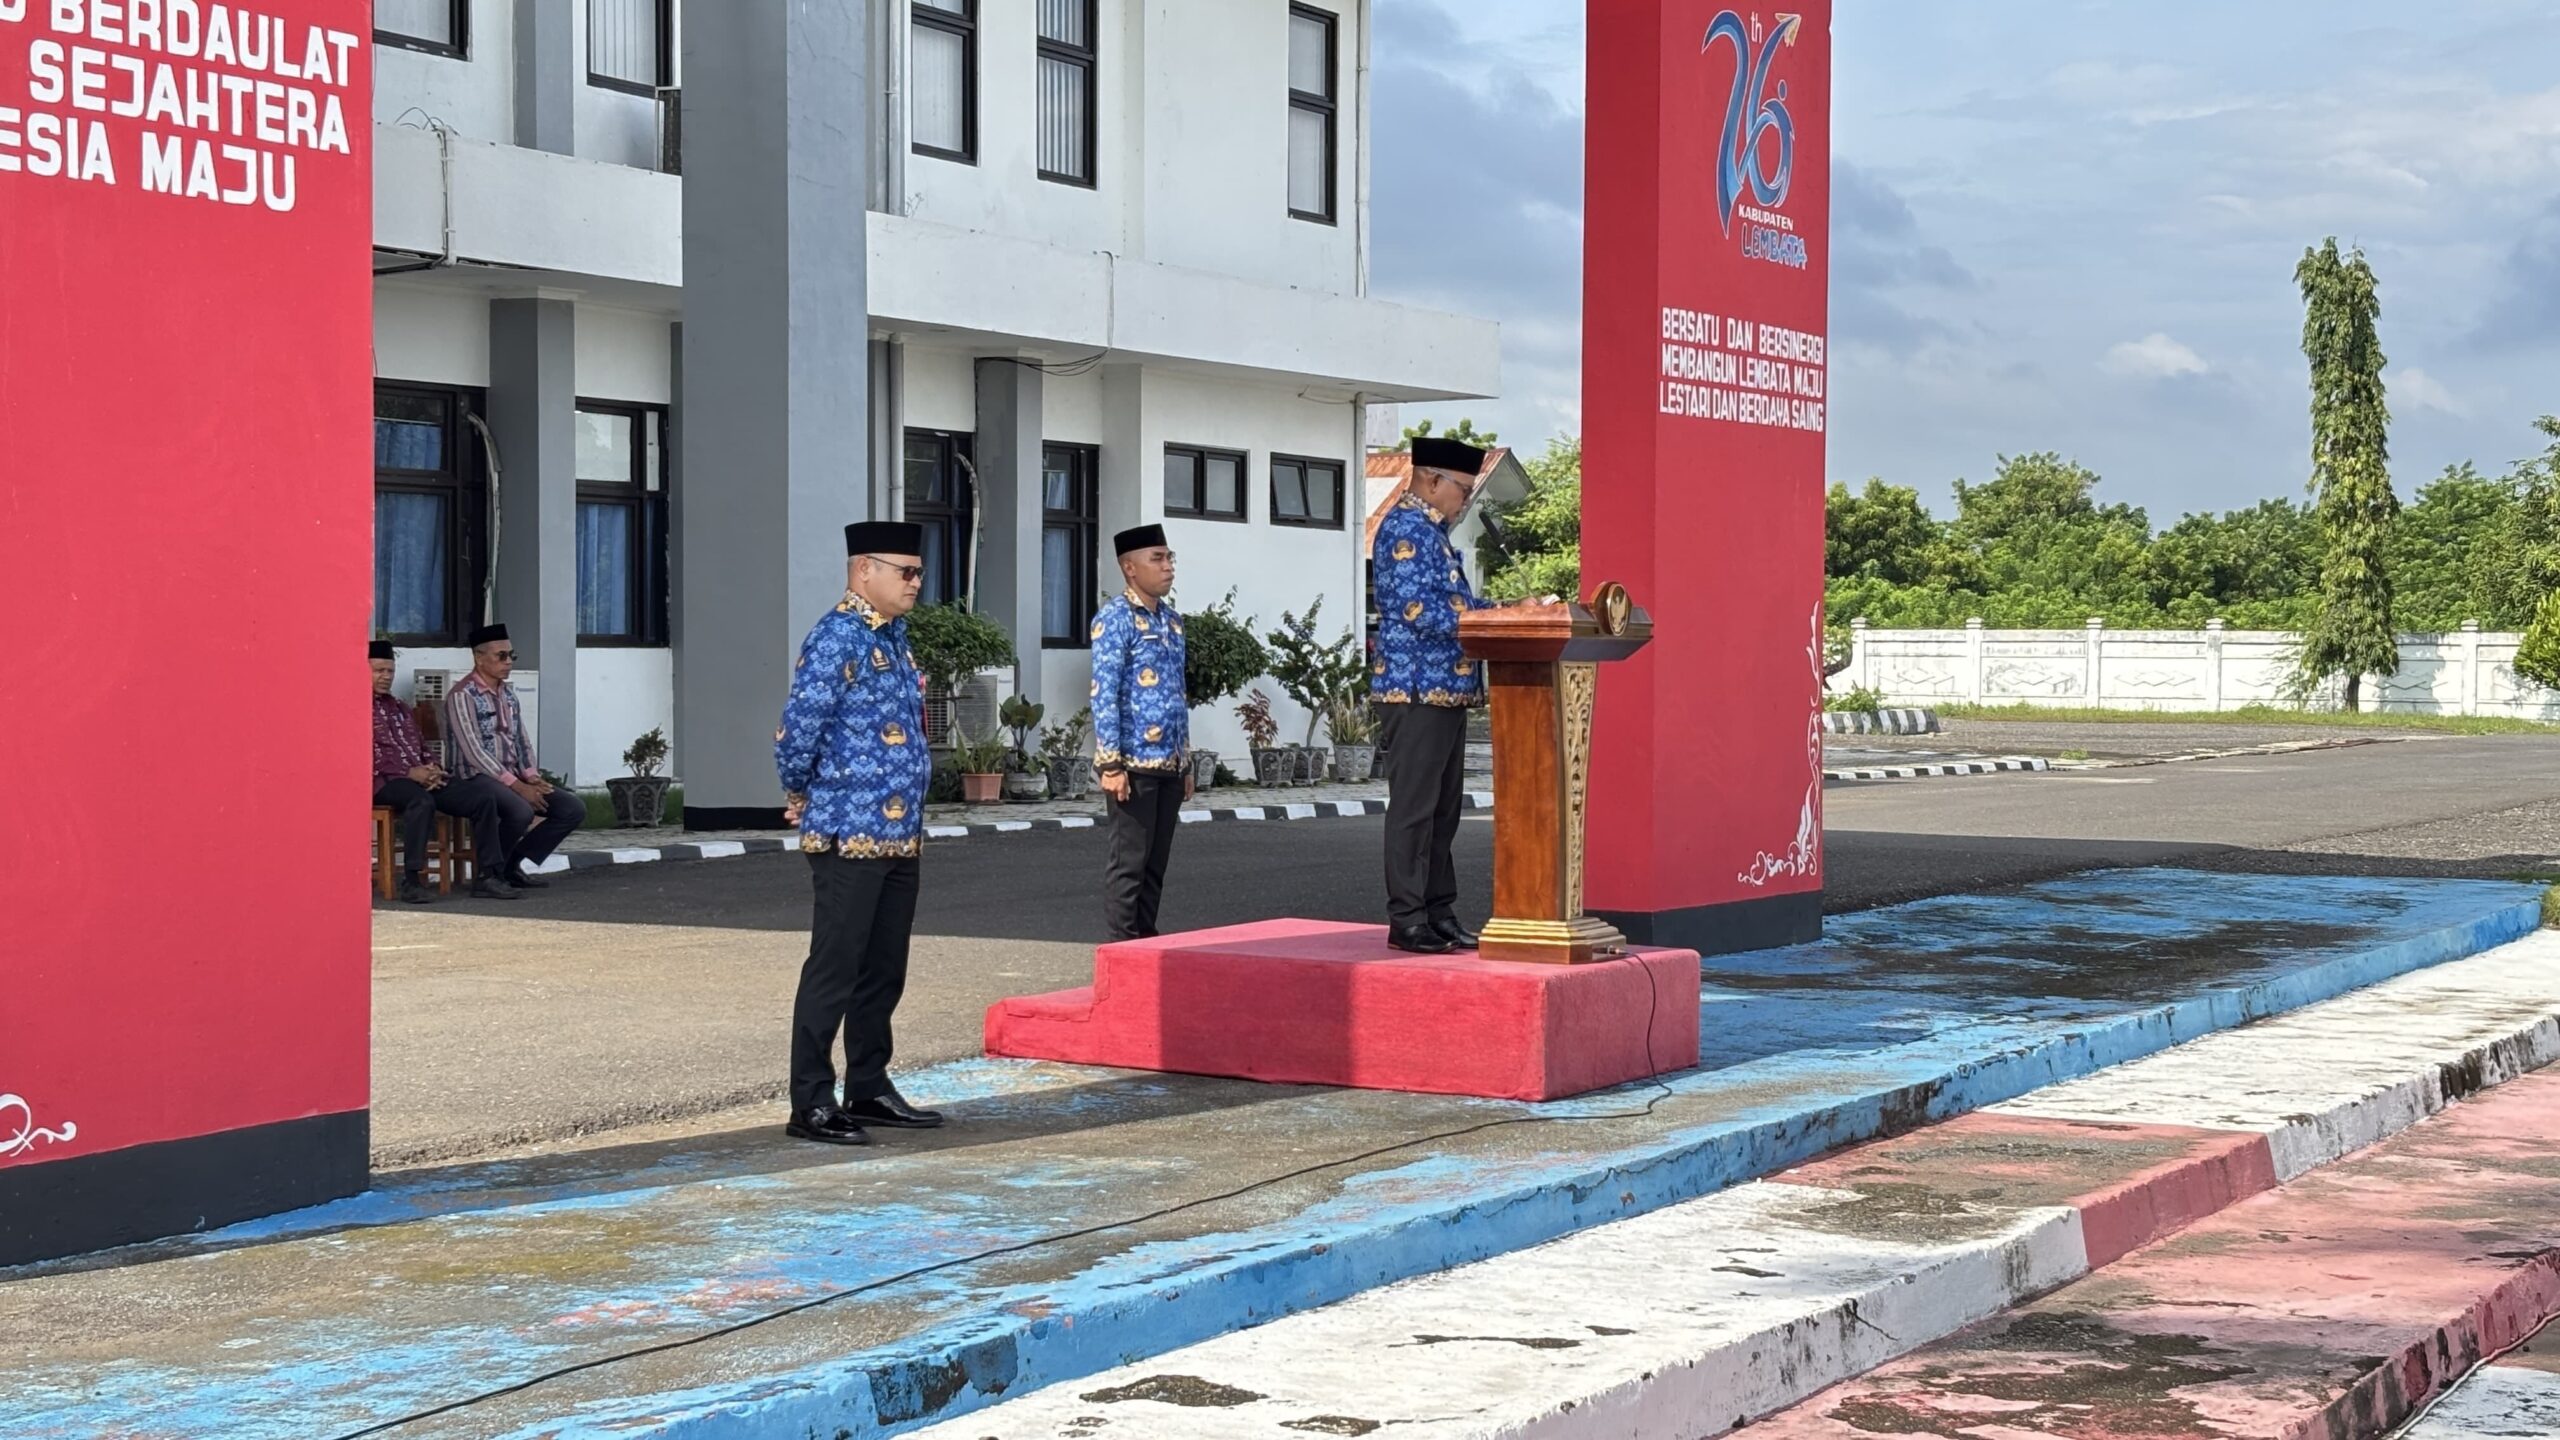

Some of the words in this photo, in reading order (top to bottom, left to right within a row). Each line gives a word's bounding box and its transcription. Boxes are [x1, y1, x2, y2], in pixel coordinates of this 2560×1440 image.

[51, 0, 359, 87] BERDAULAT
[1750, 11, 1763, 43] th
[29, 39, 351, 155] SEJAHTERA
[141, 131, 296, 212] MAJU
[1738, 203, 1794, 231] KABUPATEN
[1741, 222, 1808, 270] LEMBATA
[1662, 306, 1720, 346] BERSATU
[1727, 317, 1753, 352] DAN
[1759, 323, 1824, 366] BERSINERGI
[1662, 342, 1737, 385] MEMBANGUN
[1739, 355, 1791, 394] LEMBATA
[1794, 365, 1824, 399] MAJU
[1659, 380, 1711, 419] LESTARI
[1712, 388, 1738, 422] DAN
[1739, 392, 1790, 429] BERDAYA
[1791, 399, 1824, 433] SAING
